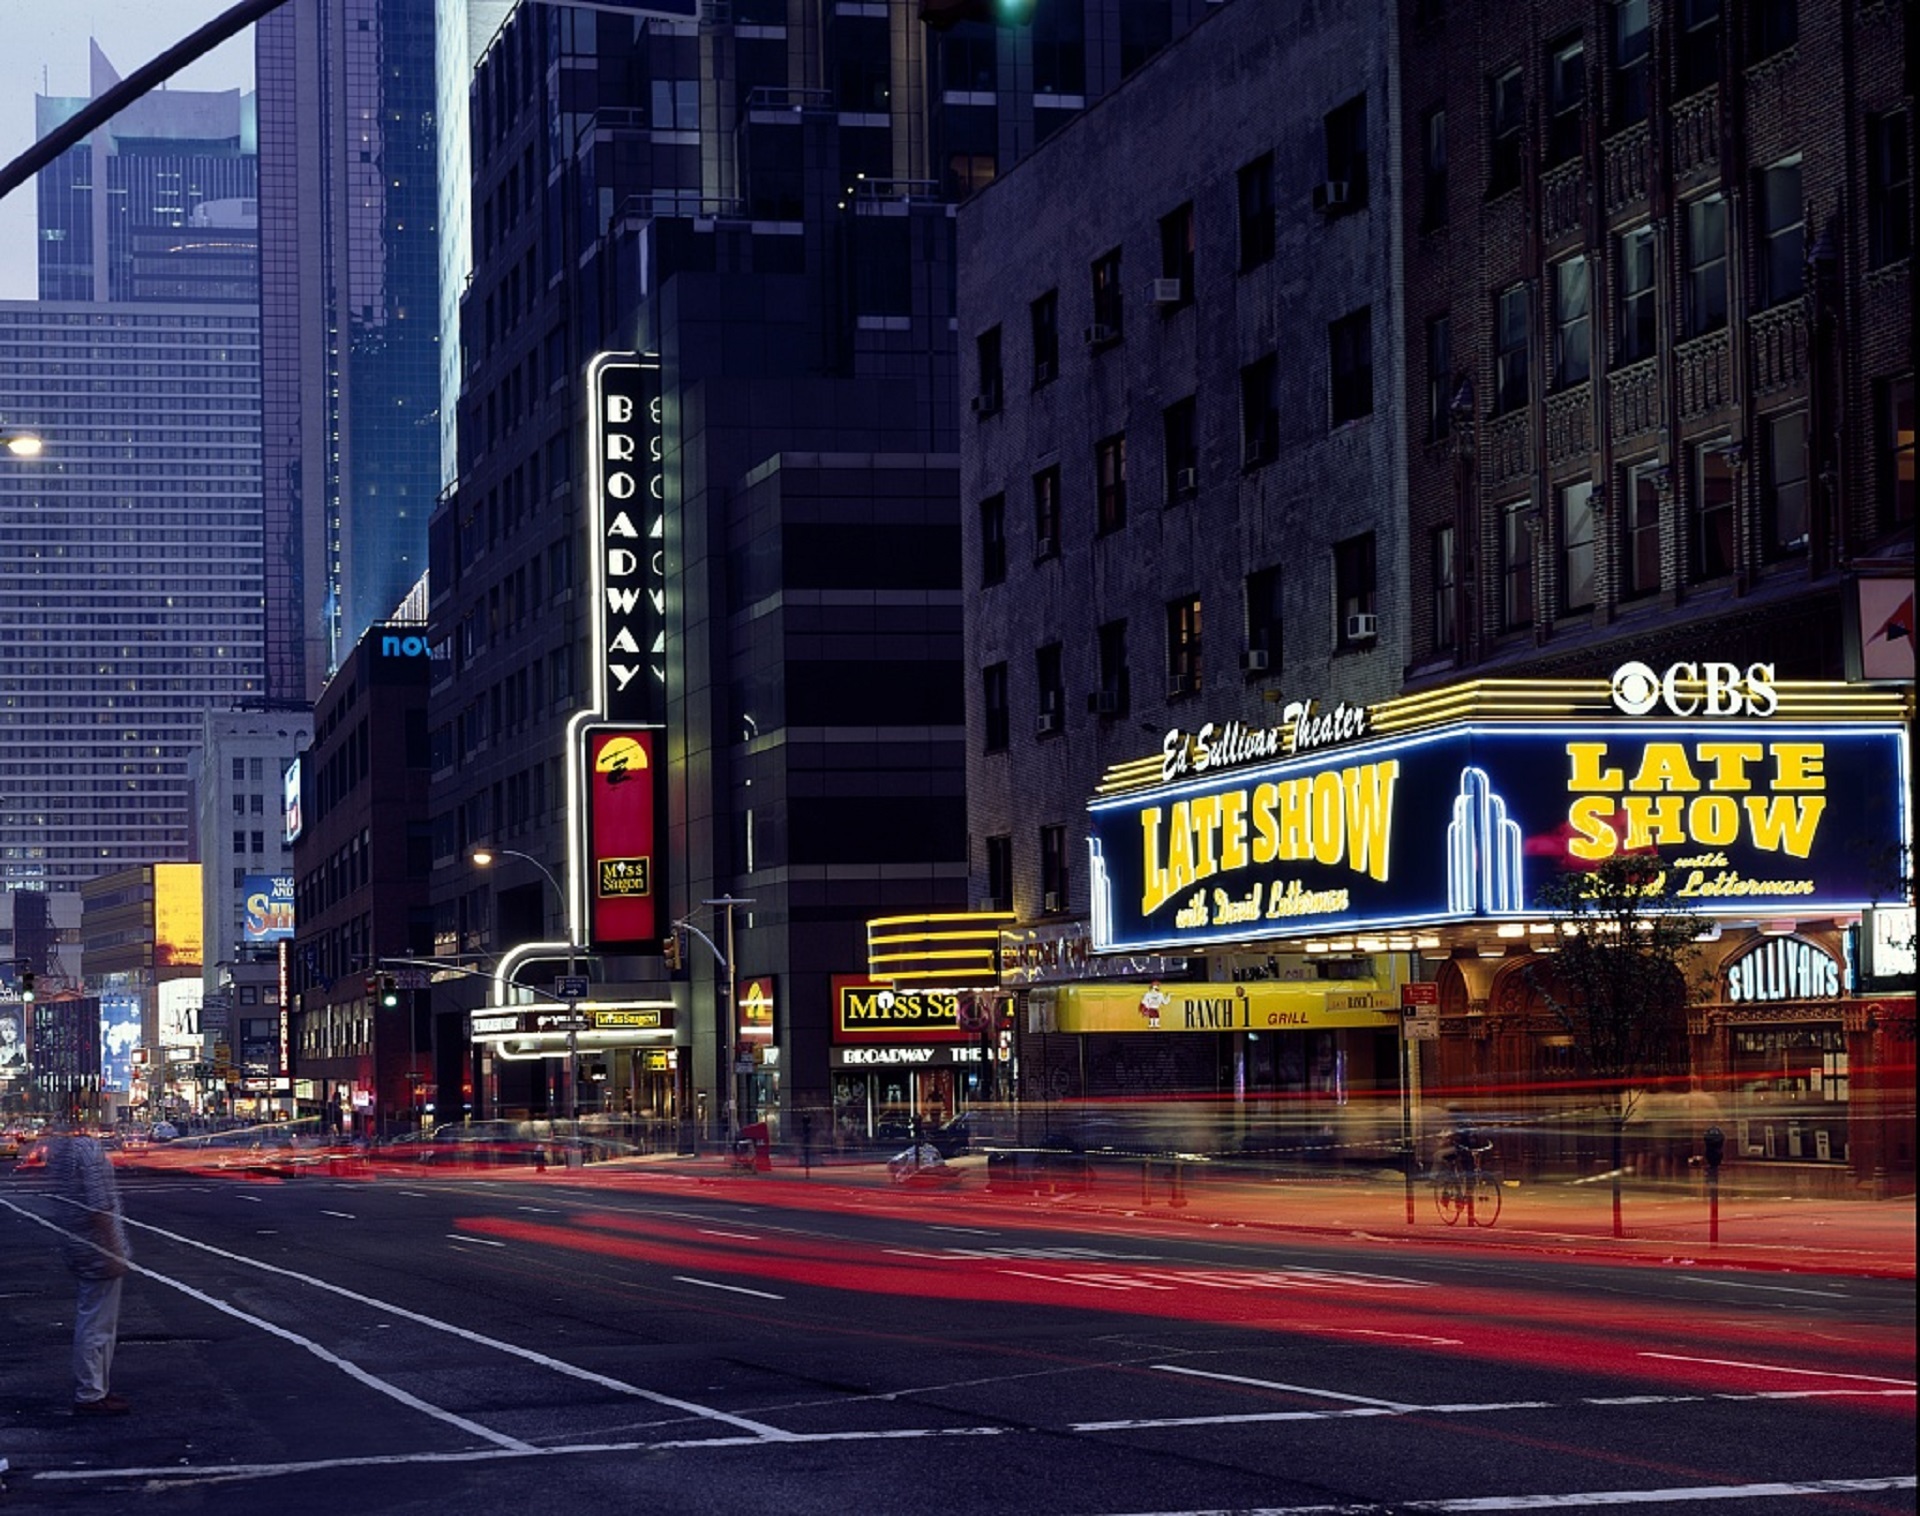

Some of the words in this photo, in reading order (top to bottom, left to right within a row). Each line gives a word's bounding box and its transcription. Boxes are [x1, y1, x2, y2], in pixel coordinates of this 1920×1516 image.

[606, 395, 640, 691] BROADWAY
[1664, 662, 1779, 717] CBS
[1162, 729, 1188, 780] Ed
[1194, 722, 1278, 771] Sullivan
[1283, 699, 1366, 752] Theater
[1566, 743, 1826, 792] LATE
[1141, 790, 1249, 916] LATE
[1252, 759, 1400, 883] SHOW
[1566, 797, 1826, 858] SHOW
[603, 862, 644, 877] Miss
[1674, 851, 1729, 868] with
[603, 878, 644, 894] Saigon
[1175, 890, 1208, 928] with
[1212, 881, 1262, 926] David
[1266, 880, 1350, 919] Letterman
[1677, 870, 1815, 898] Letterman
[1729, 936, 1839, 1001] SULLIVAN'S
[848, 991, 921, 1019] Miss
[1185, 999, 1233, 1029] RANCH
[1241, 997, 1250, 1027] 1
[1267, 1012, 1309, 1025] GRILL
[842, 1048, 934, 1063] BROADWAY
